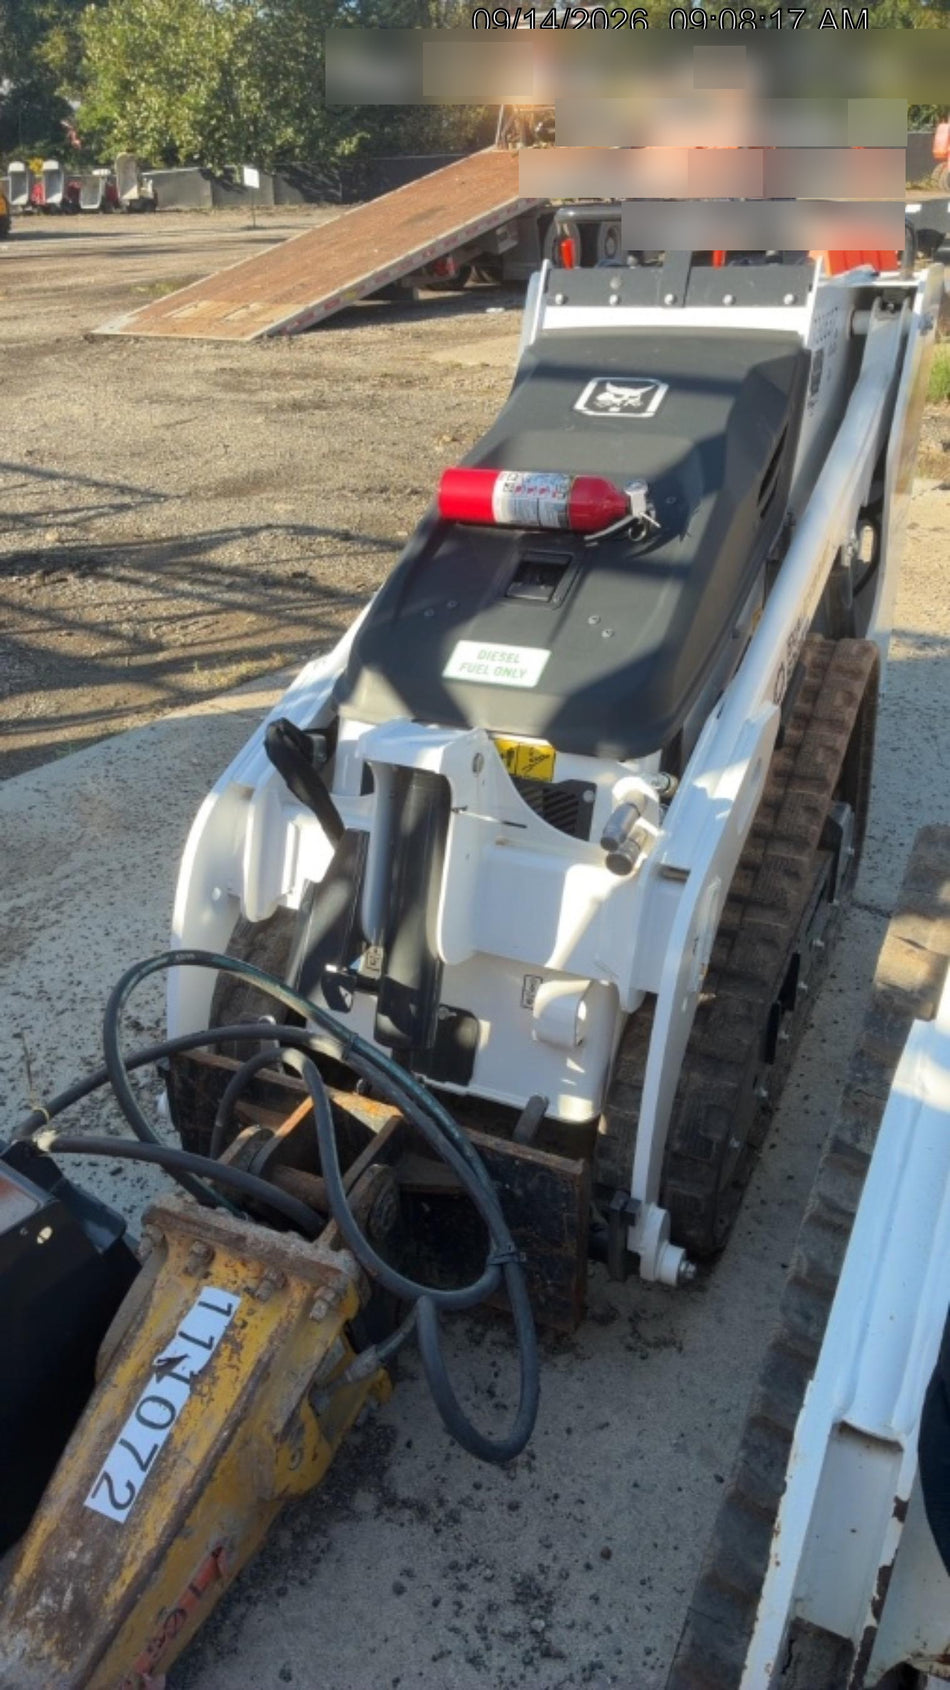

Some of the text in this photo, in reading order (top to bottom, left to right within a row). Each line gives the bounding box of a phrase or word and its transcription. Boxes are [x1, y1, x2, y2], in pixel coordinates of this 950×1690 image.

[477, 649, 520, 663] DIESEL
[458, 662, 528, 678] FUEL ONLY
